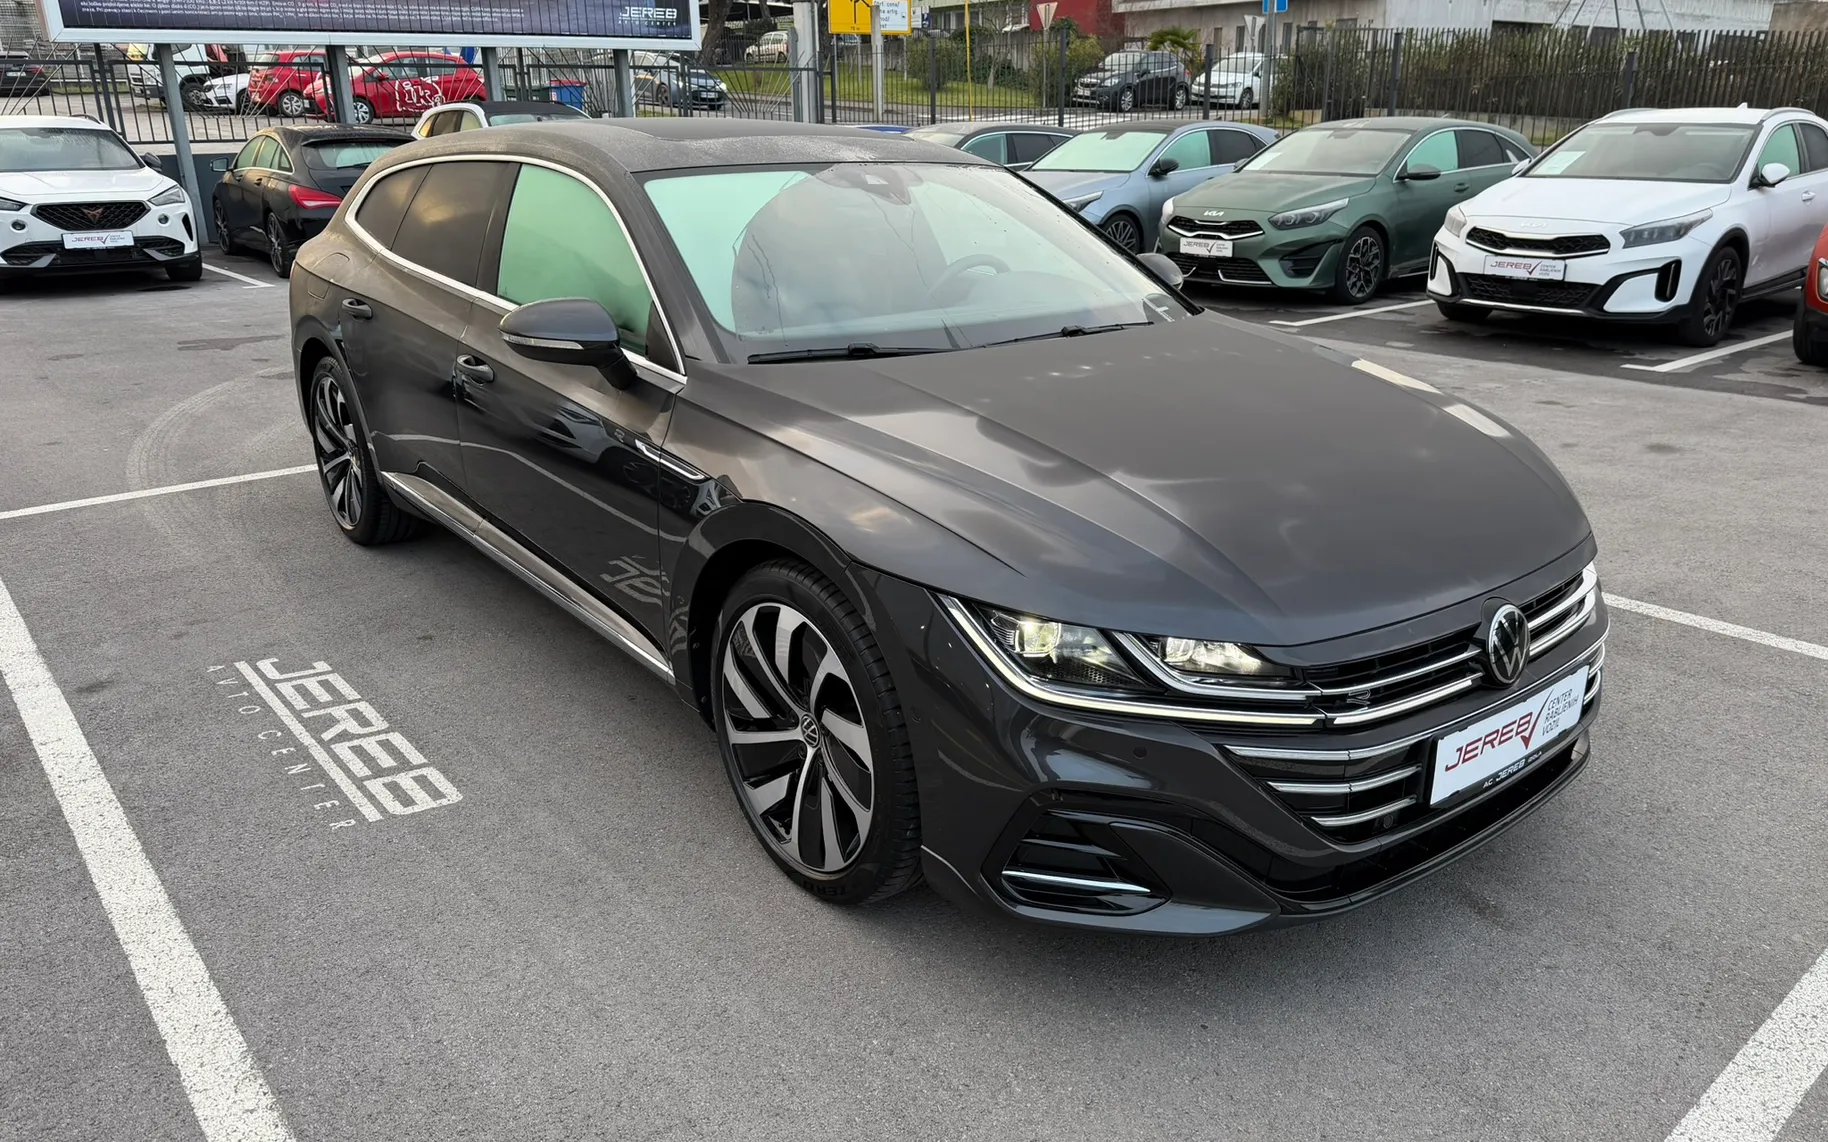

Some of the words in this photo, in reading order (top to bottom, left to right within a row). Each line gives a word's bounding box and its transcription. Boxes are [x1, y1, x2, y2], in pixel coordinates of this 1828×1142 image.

[619, 6, 677, 19] JEREB
[1490, 260, 1533, 270] JEREB
[206, 664, 261, 715] AVTO
[1547, 688, 1573, 711] CENTER
[255, 657, 464, 816] JEREB
[1444, 711, 1533, 773] JEREB
[258, 729, 356, 830] CENTER
[1482, 777, 1493, 789] AC
[1496, 757, 1526, 782] JEREB
